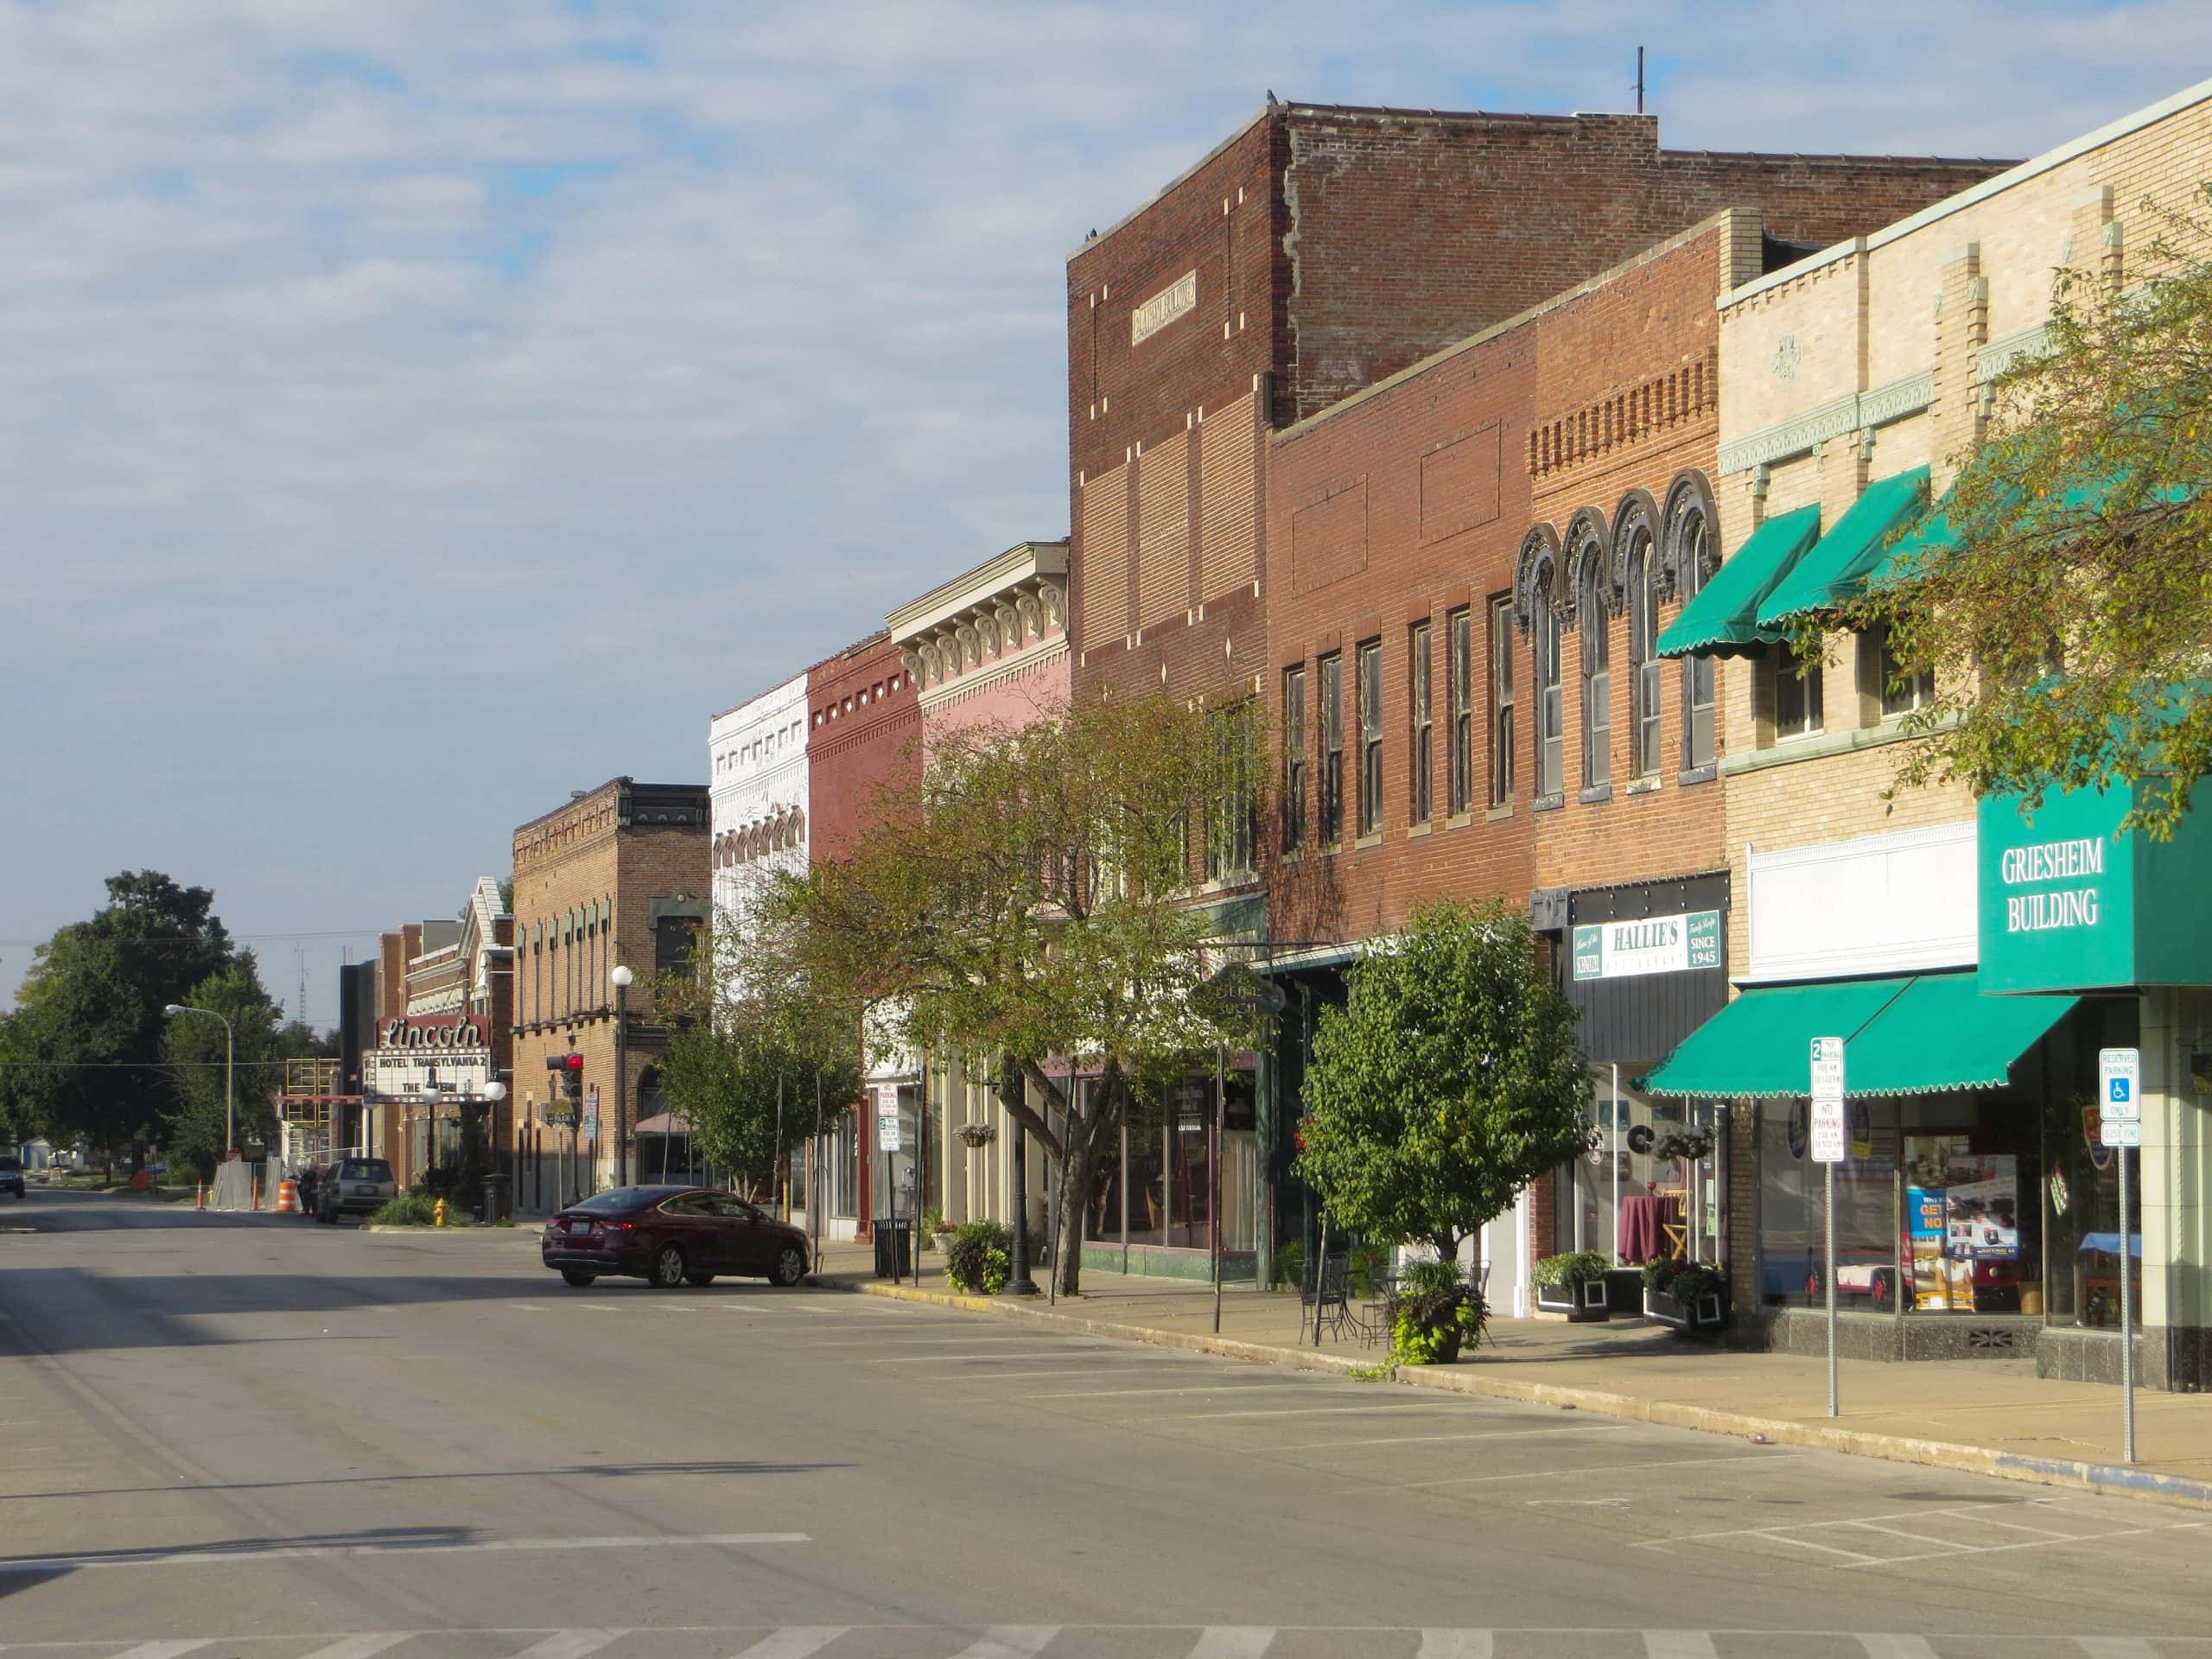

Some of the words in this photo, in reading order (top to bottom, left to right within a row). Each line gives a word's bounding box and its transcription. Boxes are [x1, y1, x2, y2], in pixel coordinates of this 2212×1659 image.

[2002, 837, 2102, 884] GRIESHEIM
[2007, 888, 2097, 932] BUILDING
[1613, 920, 1678, 951] HALLIE'S
[1690, 937, 1715, 950] SINCE
[1692, 950, 1715, 964] 1945
[379, 1015, 481, 1049] Lincoln
[1813, 1042, 1821, 1058] 2
[379, 1058, 408, 1068] HOTEL
[412, 1057, 480, 1067] TRANSYLVANIA
[480, 1057, 486, 1066] 2
[2101, 1054, 2136, 1063] RESERVED
[402, 1083, 419, 1093] THE
[1821, 1104, 1833, 1115] NO
[2110, 1106, 2129, 1115] ONLY
[1815, 1118, 1841, 1128] PARKING
